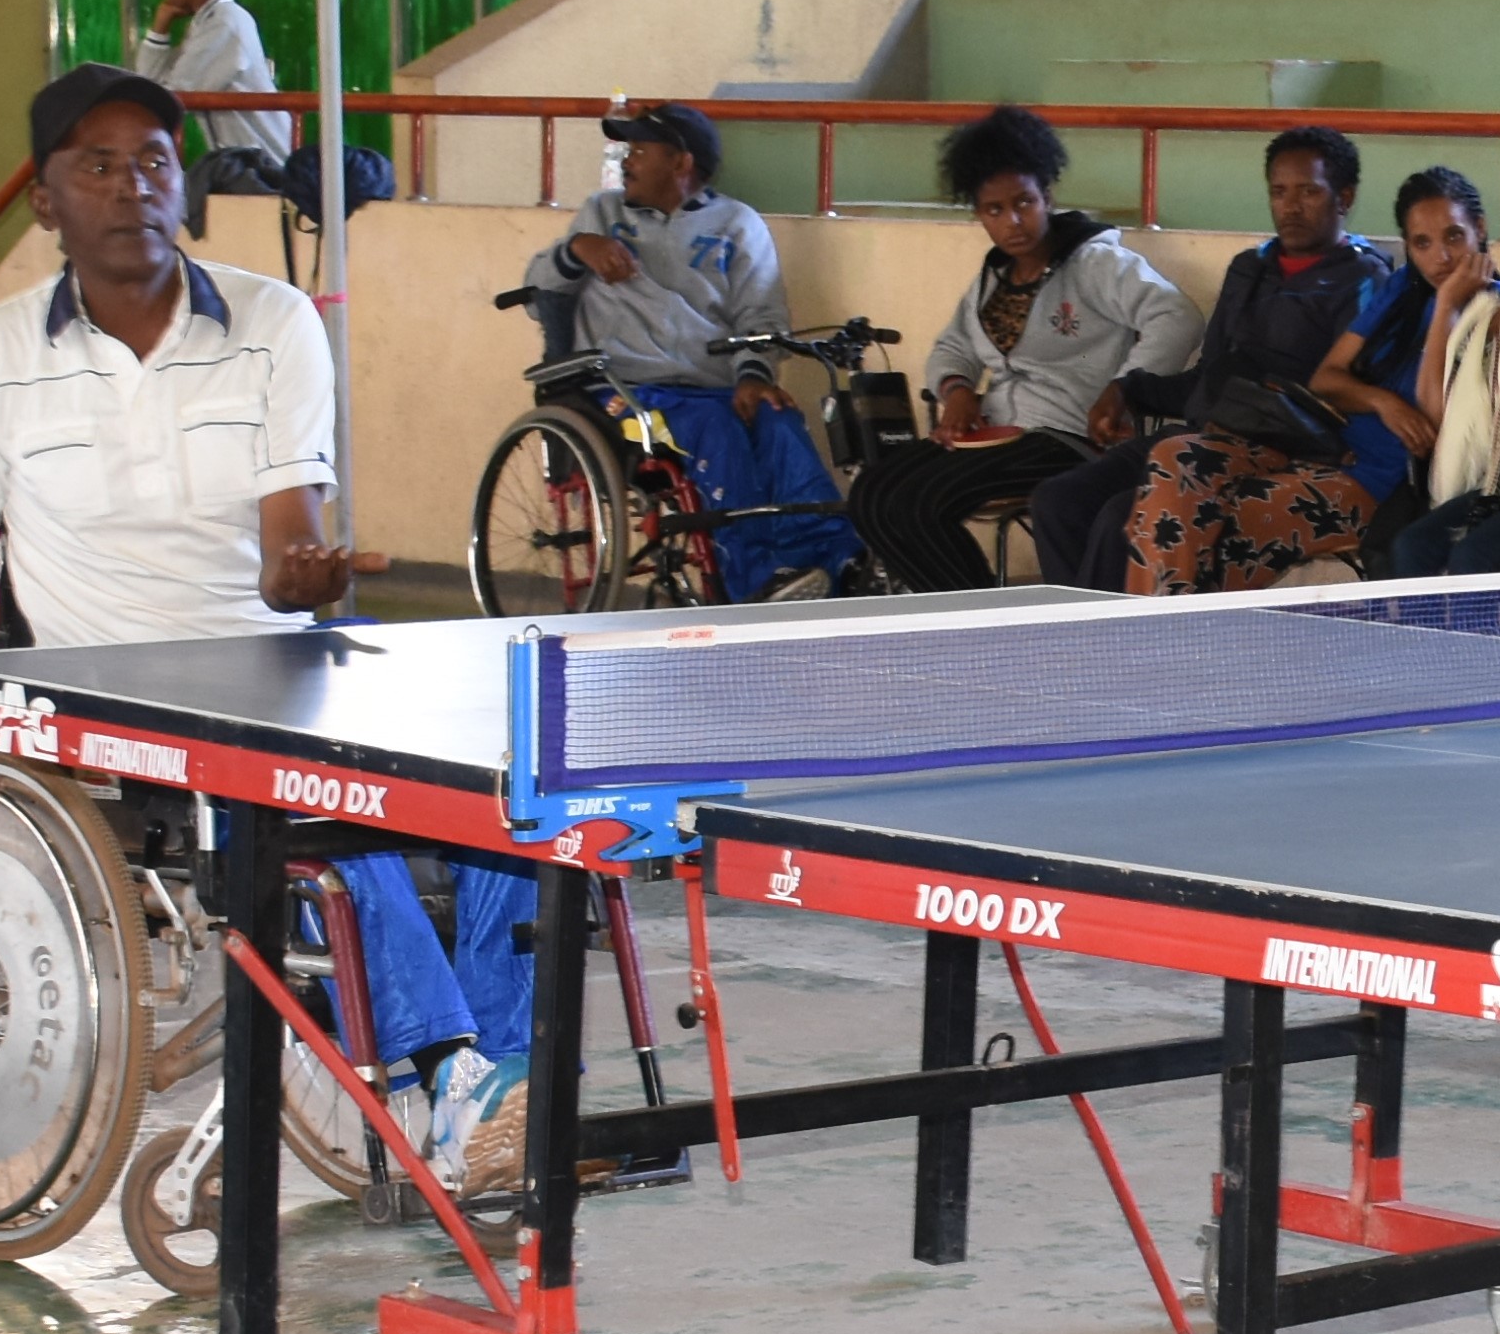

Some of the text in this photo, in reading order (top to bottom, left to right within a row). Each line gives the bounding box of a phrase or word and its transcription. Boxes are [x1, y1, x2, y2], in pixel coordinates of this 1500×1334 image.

[78, 732, 189, 784] INTERNATIONAL
[272, 768, 341, 812] 1000
[343, 777, 388, 819] DX
[565, 796, 625, 816] DHS
[914, 883, 1003, 933] 1000
[1006, 895, 1065, 940] DX
[1262, 937, 1437, 1006] INTERNATIONAL
